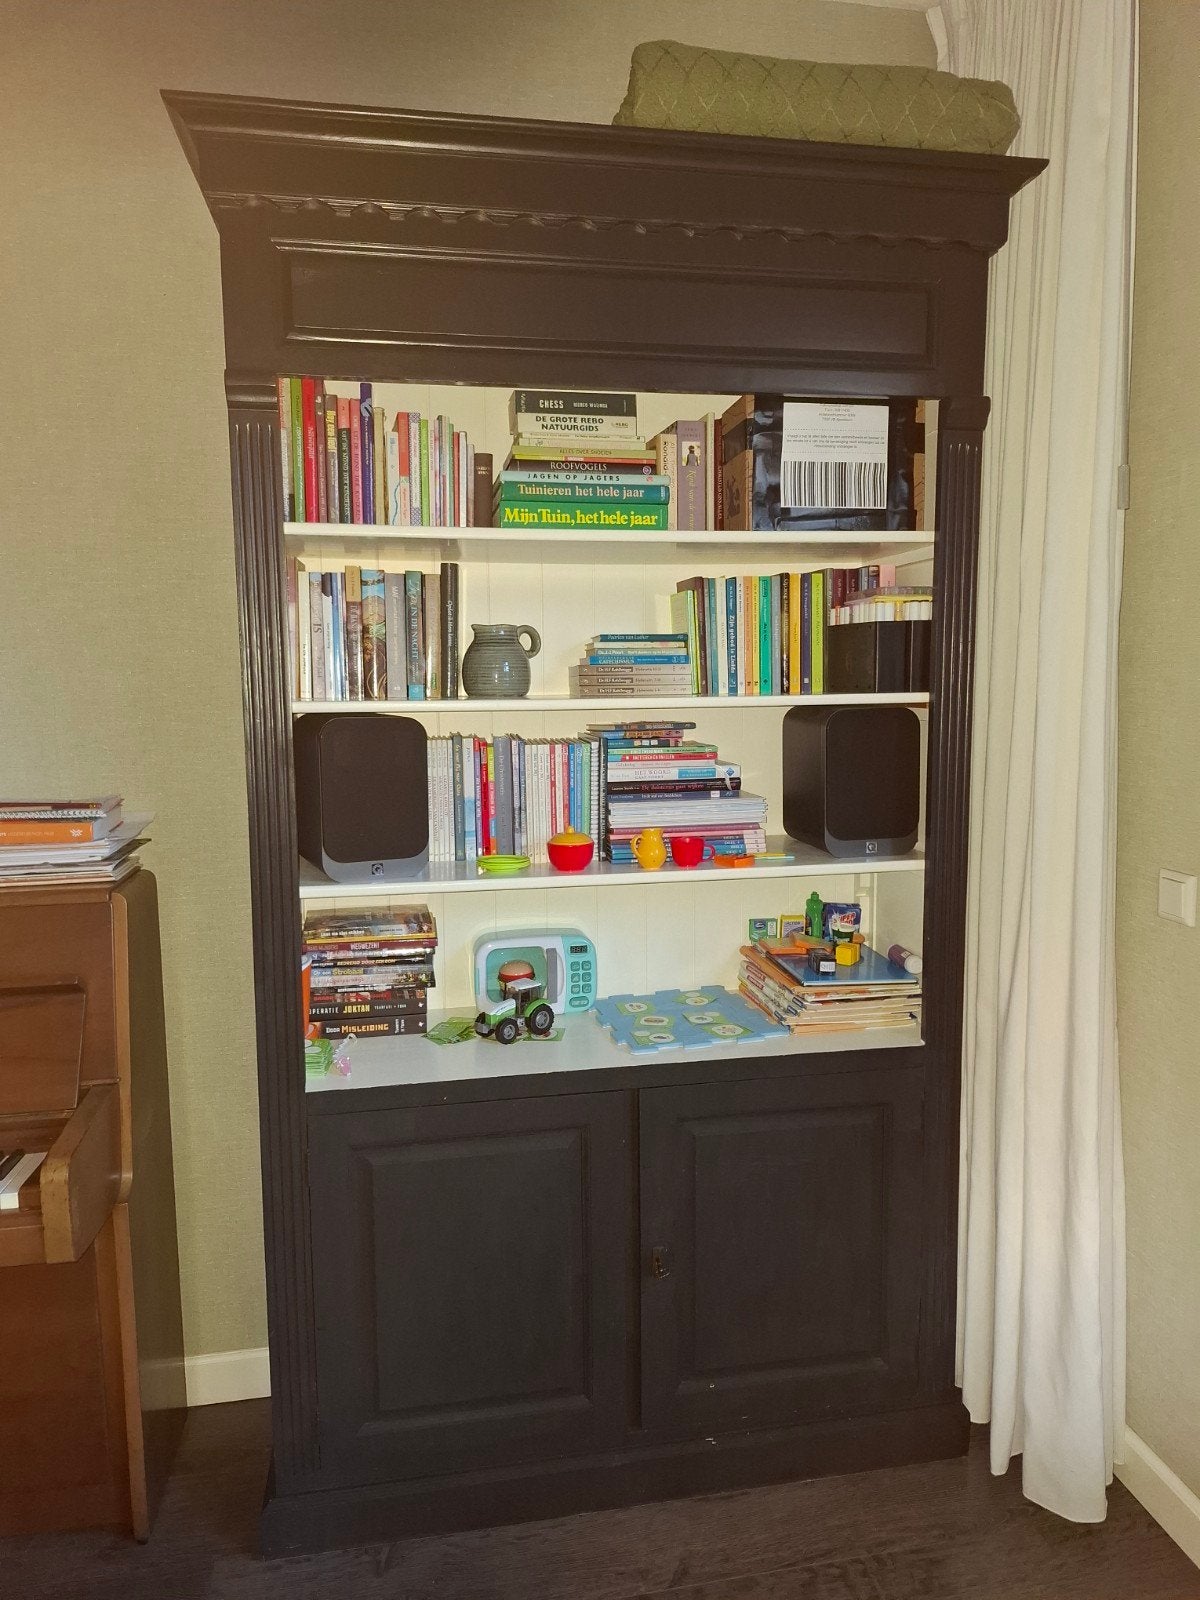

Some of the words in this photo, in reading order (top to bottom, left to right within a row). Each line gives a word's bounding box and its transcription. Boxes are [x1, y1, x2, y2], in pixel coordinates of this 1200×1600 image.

[540, 399, 564, 409] CHESS
[549, 416, 578, 424] GROTE
[541, 423, 599, 432] NATUURGIDS
[550, 461, 608, 471] ROOFVOGELS
[517, 484, 572, 496] Tuinieren
[575, 485, 593, 497] het
[596, 486, 620, 497] hele
[622, 487, 645, 500] jaar
[503, 508, 538, 525] Mijn
[538, 508, 575, 525] Tuin,
[576, 510, 599, 524] het
[599, 510, 628, 524] hele
[629, 511, 658, 527] jaar
[411, 607, 419, 617] IN
[411, 618, 419, 630] DE
[411, 631, 419, 660] NACHT
[343, 1004, 370, 1014] JOKTAN
